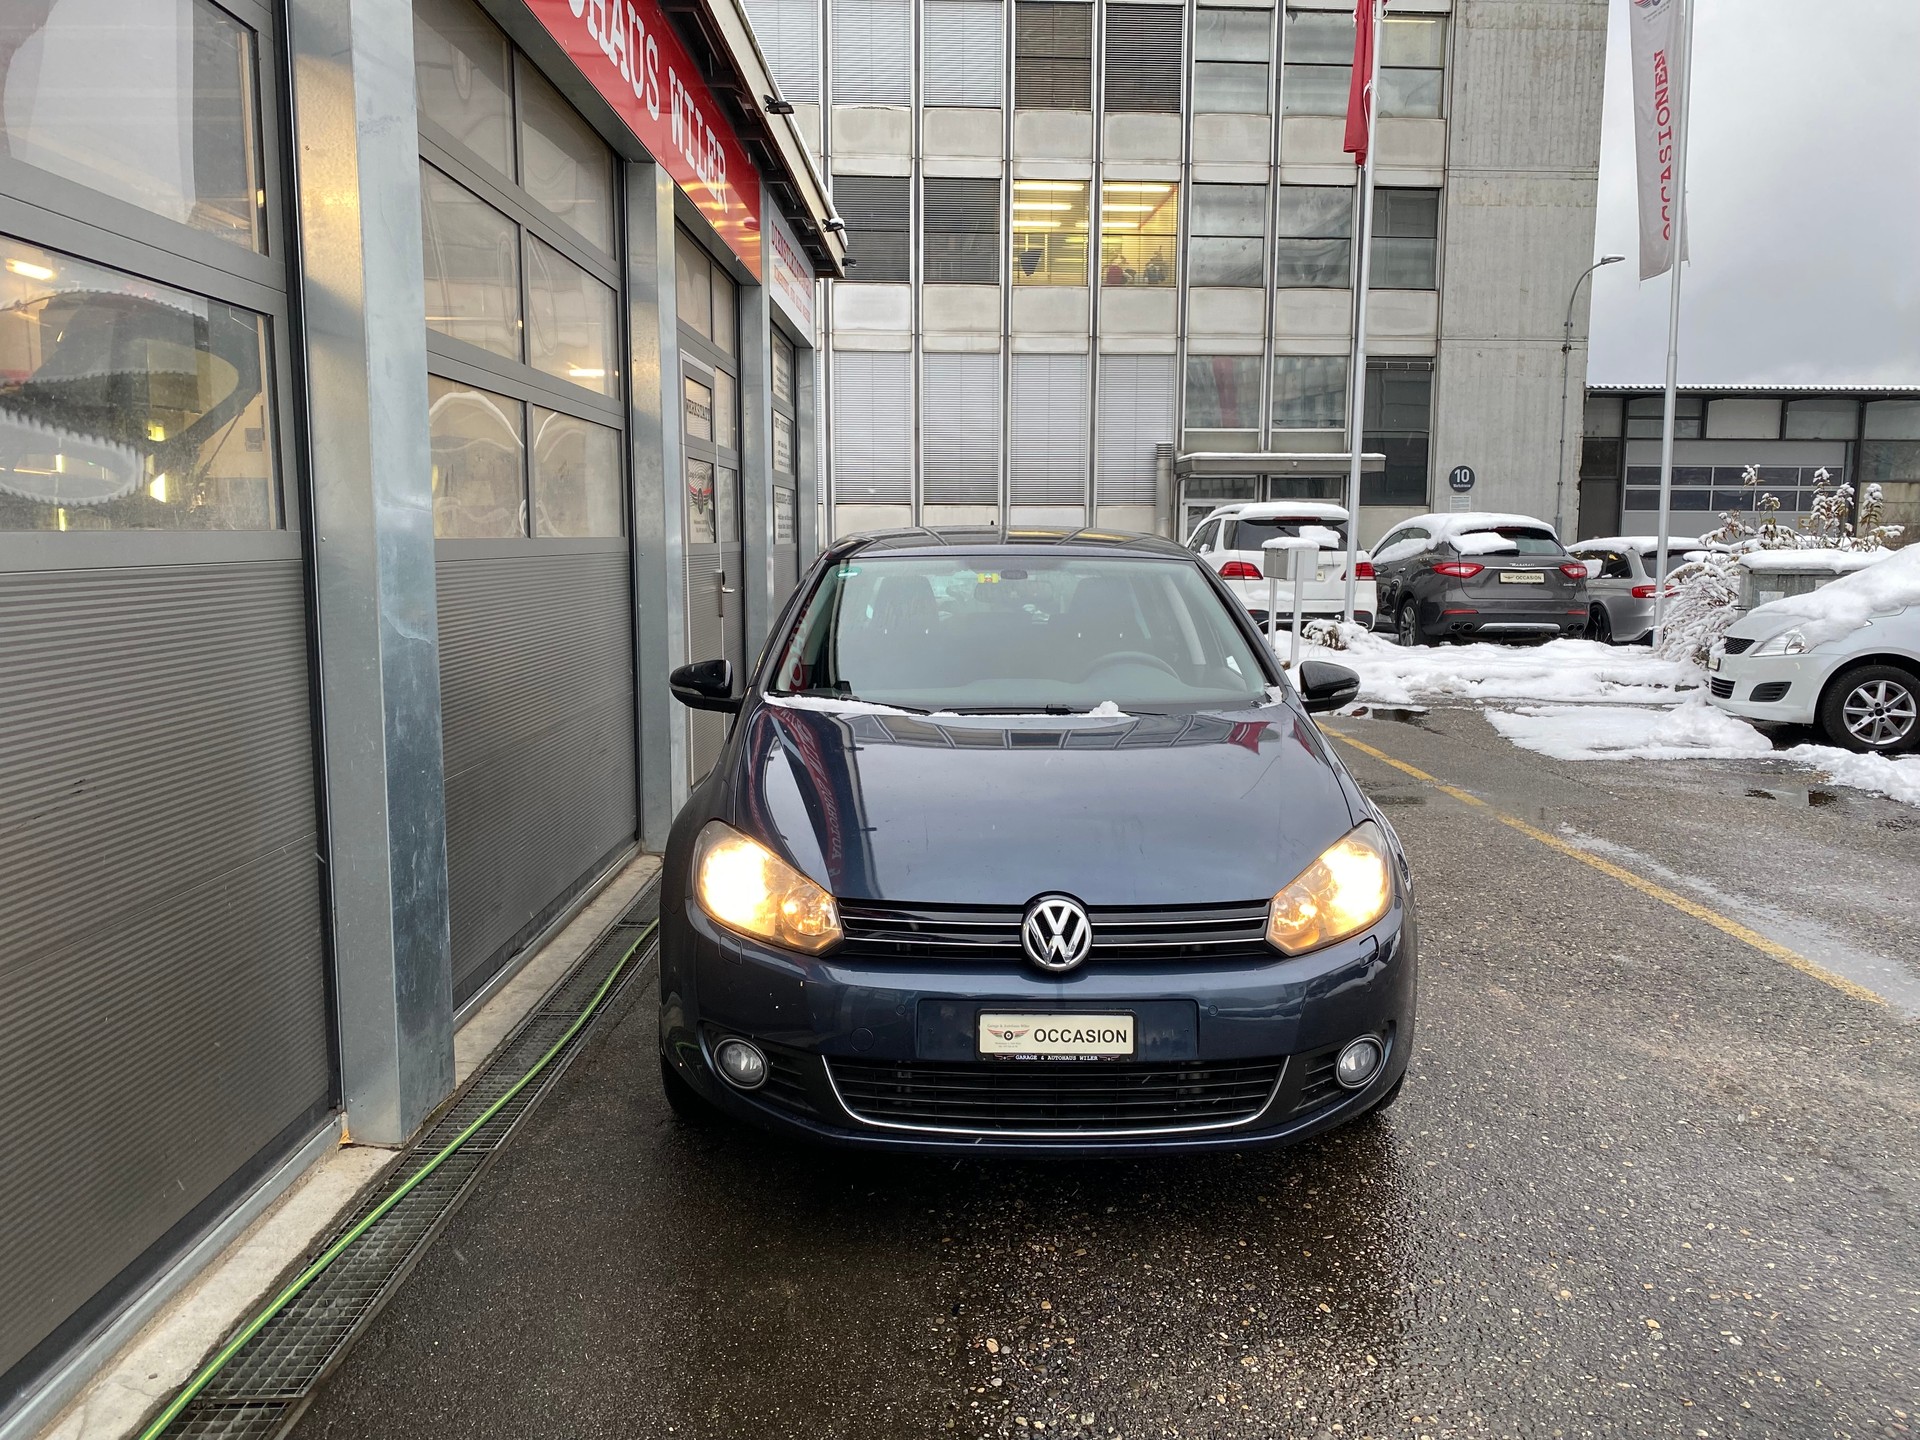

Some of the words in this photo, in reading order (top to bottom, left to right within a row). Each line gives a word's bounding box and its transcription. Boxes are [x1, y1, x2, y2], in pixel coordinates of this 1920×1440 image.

[568, 0, 660, 121] HAUS
[668, 66, 728, 213] WILER
[1654, 50, 1672, 241] OCCASIONEN
[1454, 469, 1470, 483] 10
[1034, 1028, 1127, 1043] OCCASION
